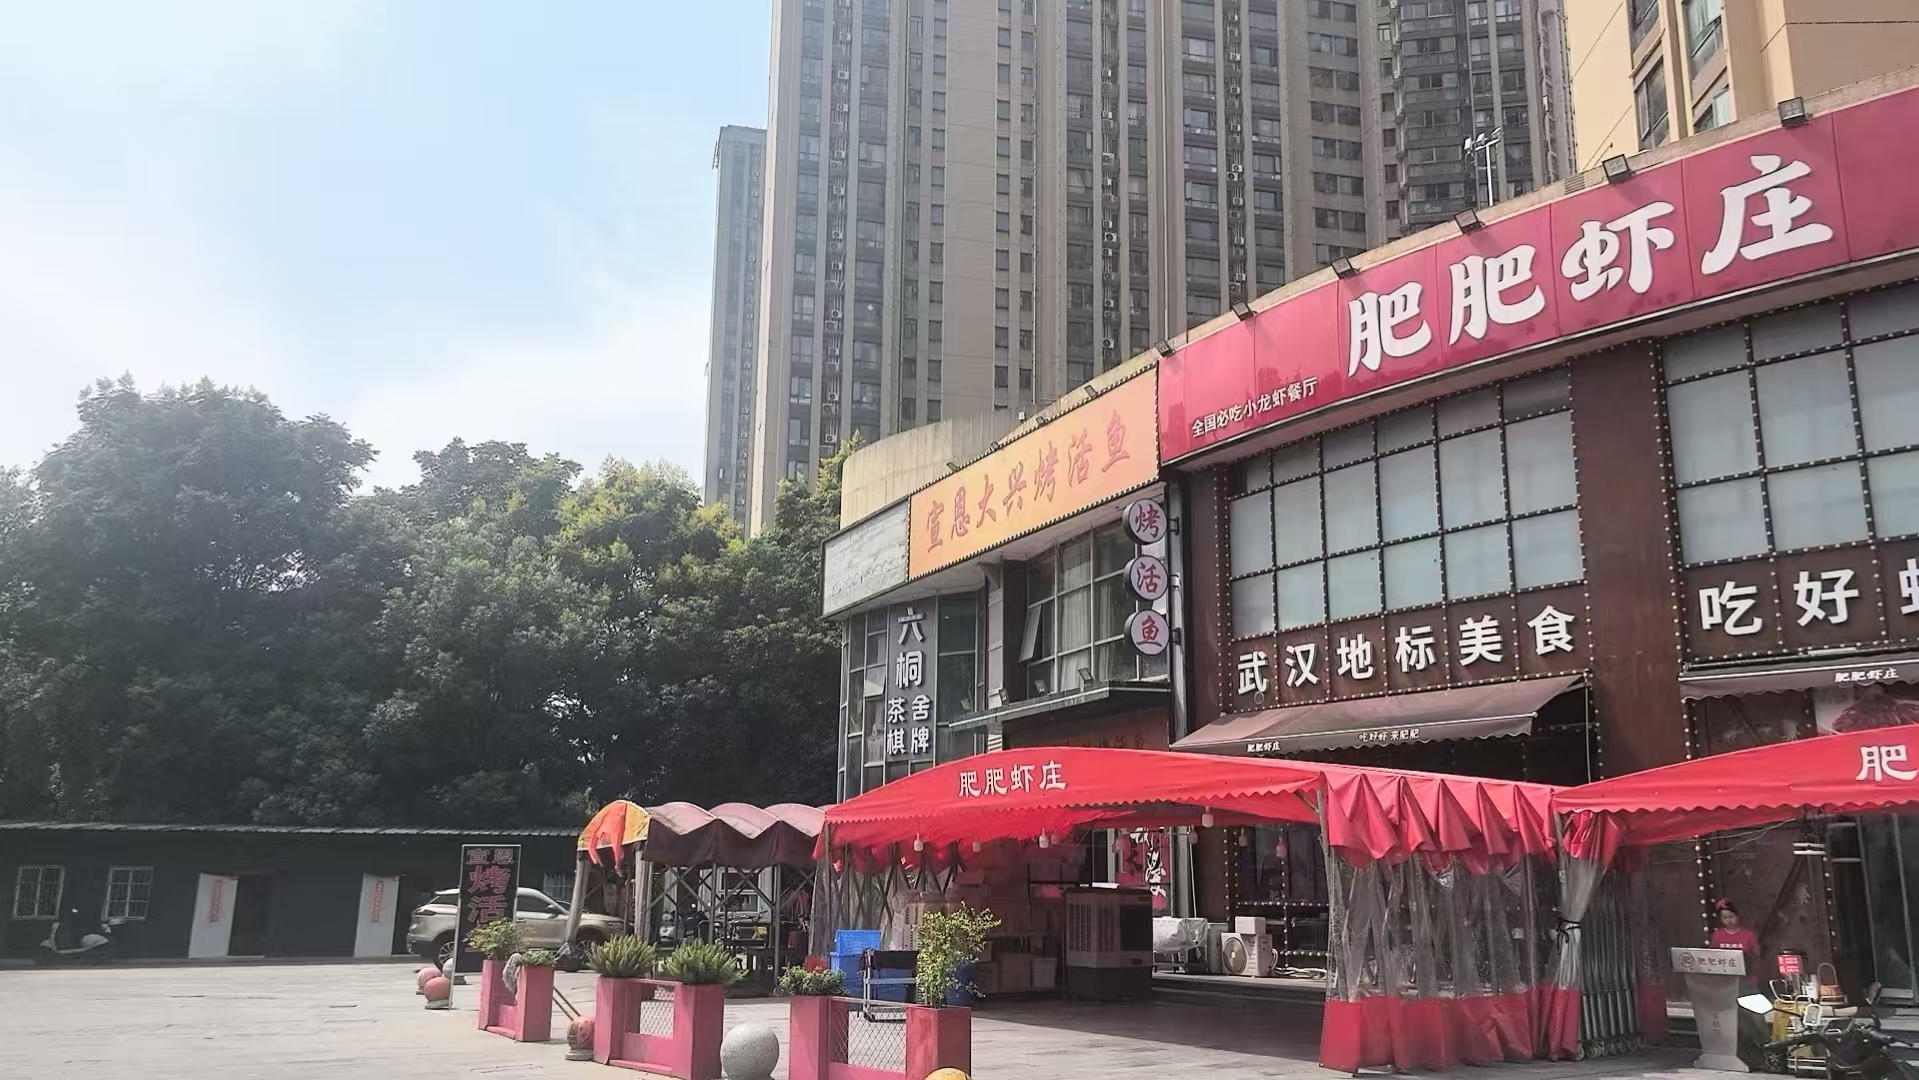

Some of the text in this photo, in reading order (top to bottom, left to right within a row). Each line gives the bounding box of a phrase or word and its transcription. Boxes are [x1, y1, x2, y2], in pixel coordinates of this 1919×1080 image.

[1347, 155, 1834, 378] 肥肥虾庄
[1192, 376, 1318, 438] 全国必吃小龙虾餐厅
[926, 409, 1130, 553] 宣恩大兴烤活鱼
[1237, 604, 1575, 695] 武汉地标美食
[1835, 667, 1899, 683] 肥肥虾庄
[1247, 740, 1281, 753] 肥肥虾庄
[1855, 744, 1919, 782] 肥
[958, 760, 1067, 798] 肥肥虾庄
